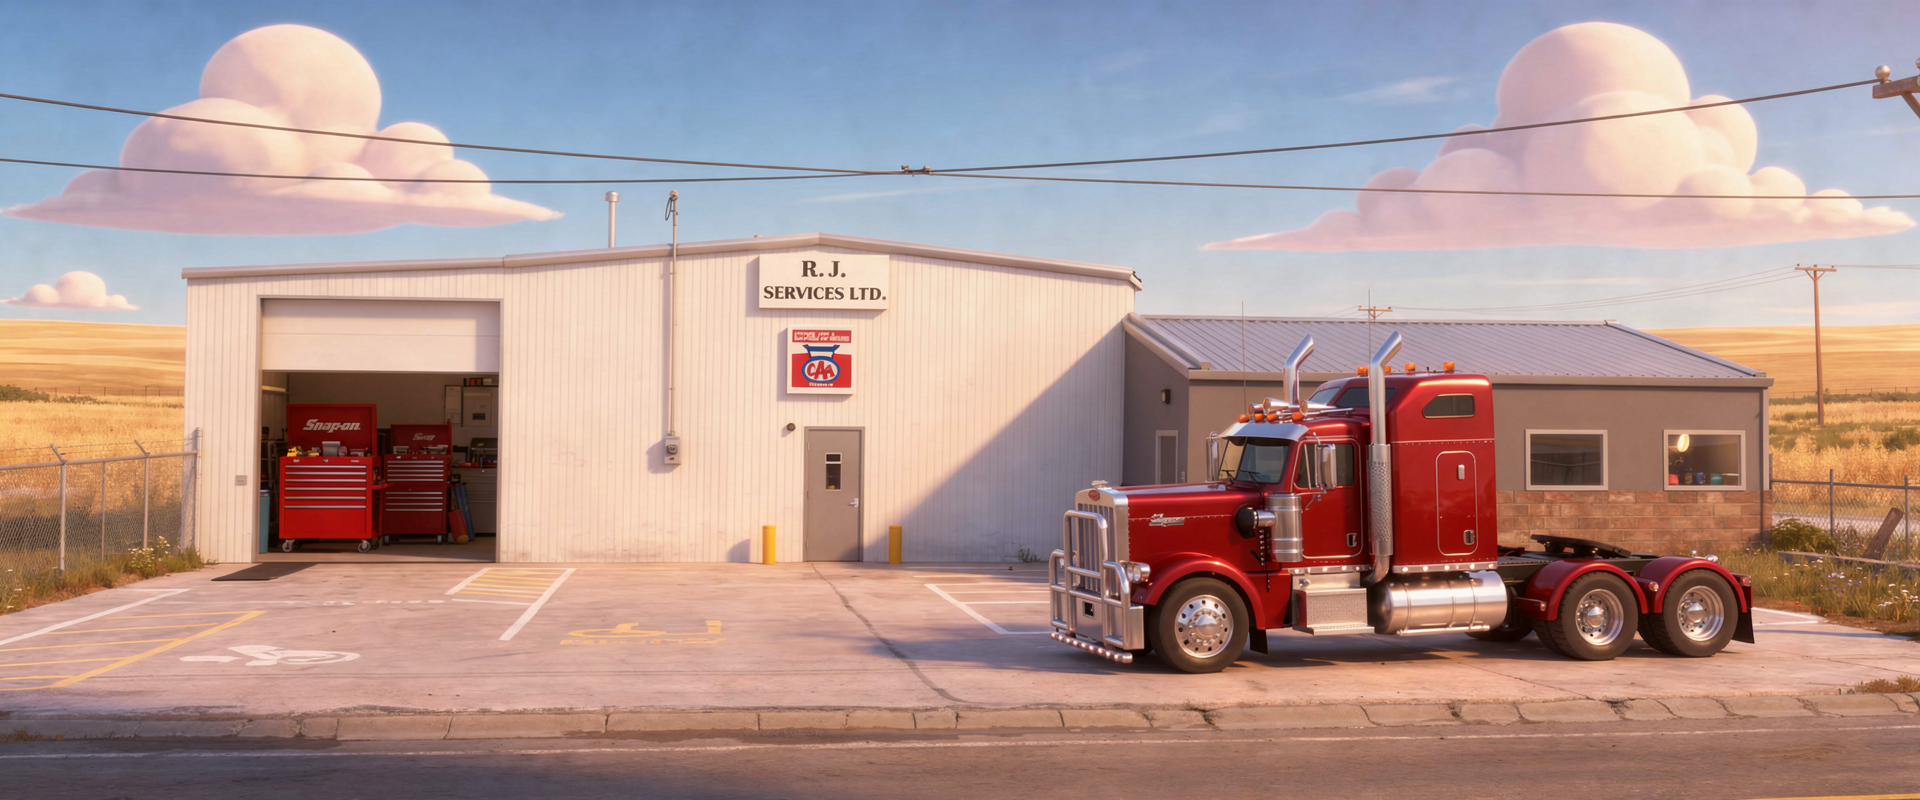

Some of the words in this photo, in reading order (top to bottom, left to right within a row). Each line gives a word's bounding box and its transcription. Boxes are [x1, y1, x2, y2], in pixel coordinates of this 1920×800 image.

[801, 260, 824, 277] R.
[828, 260, 846, 278] J.
[763, 286, 844, 300] SERVICES
[850, 287, 887, 300] LTD.
[806, 360, 835, 380] CAA
